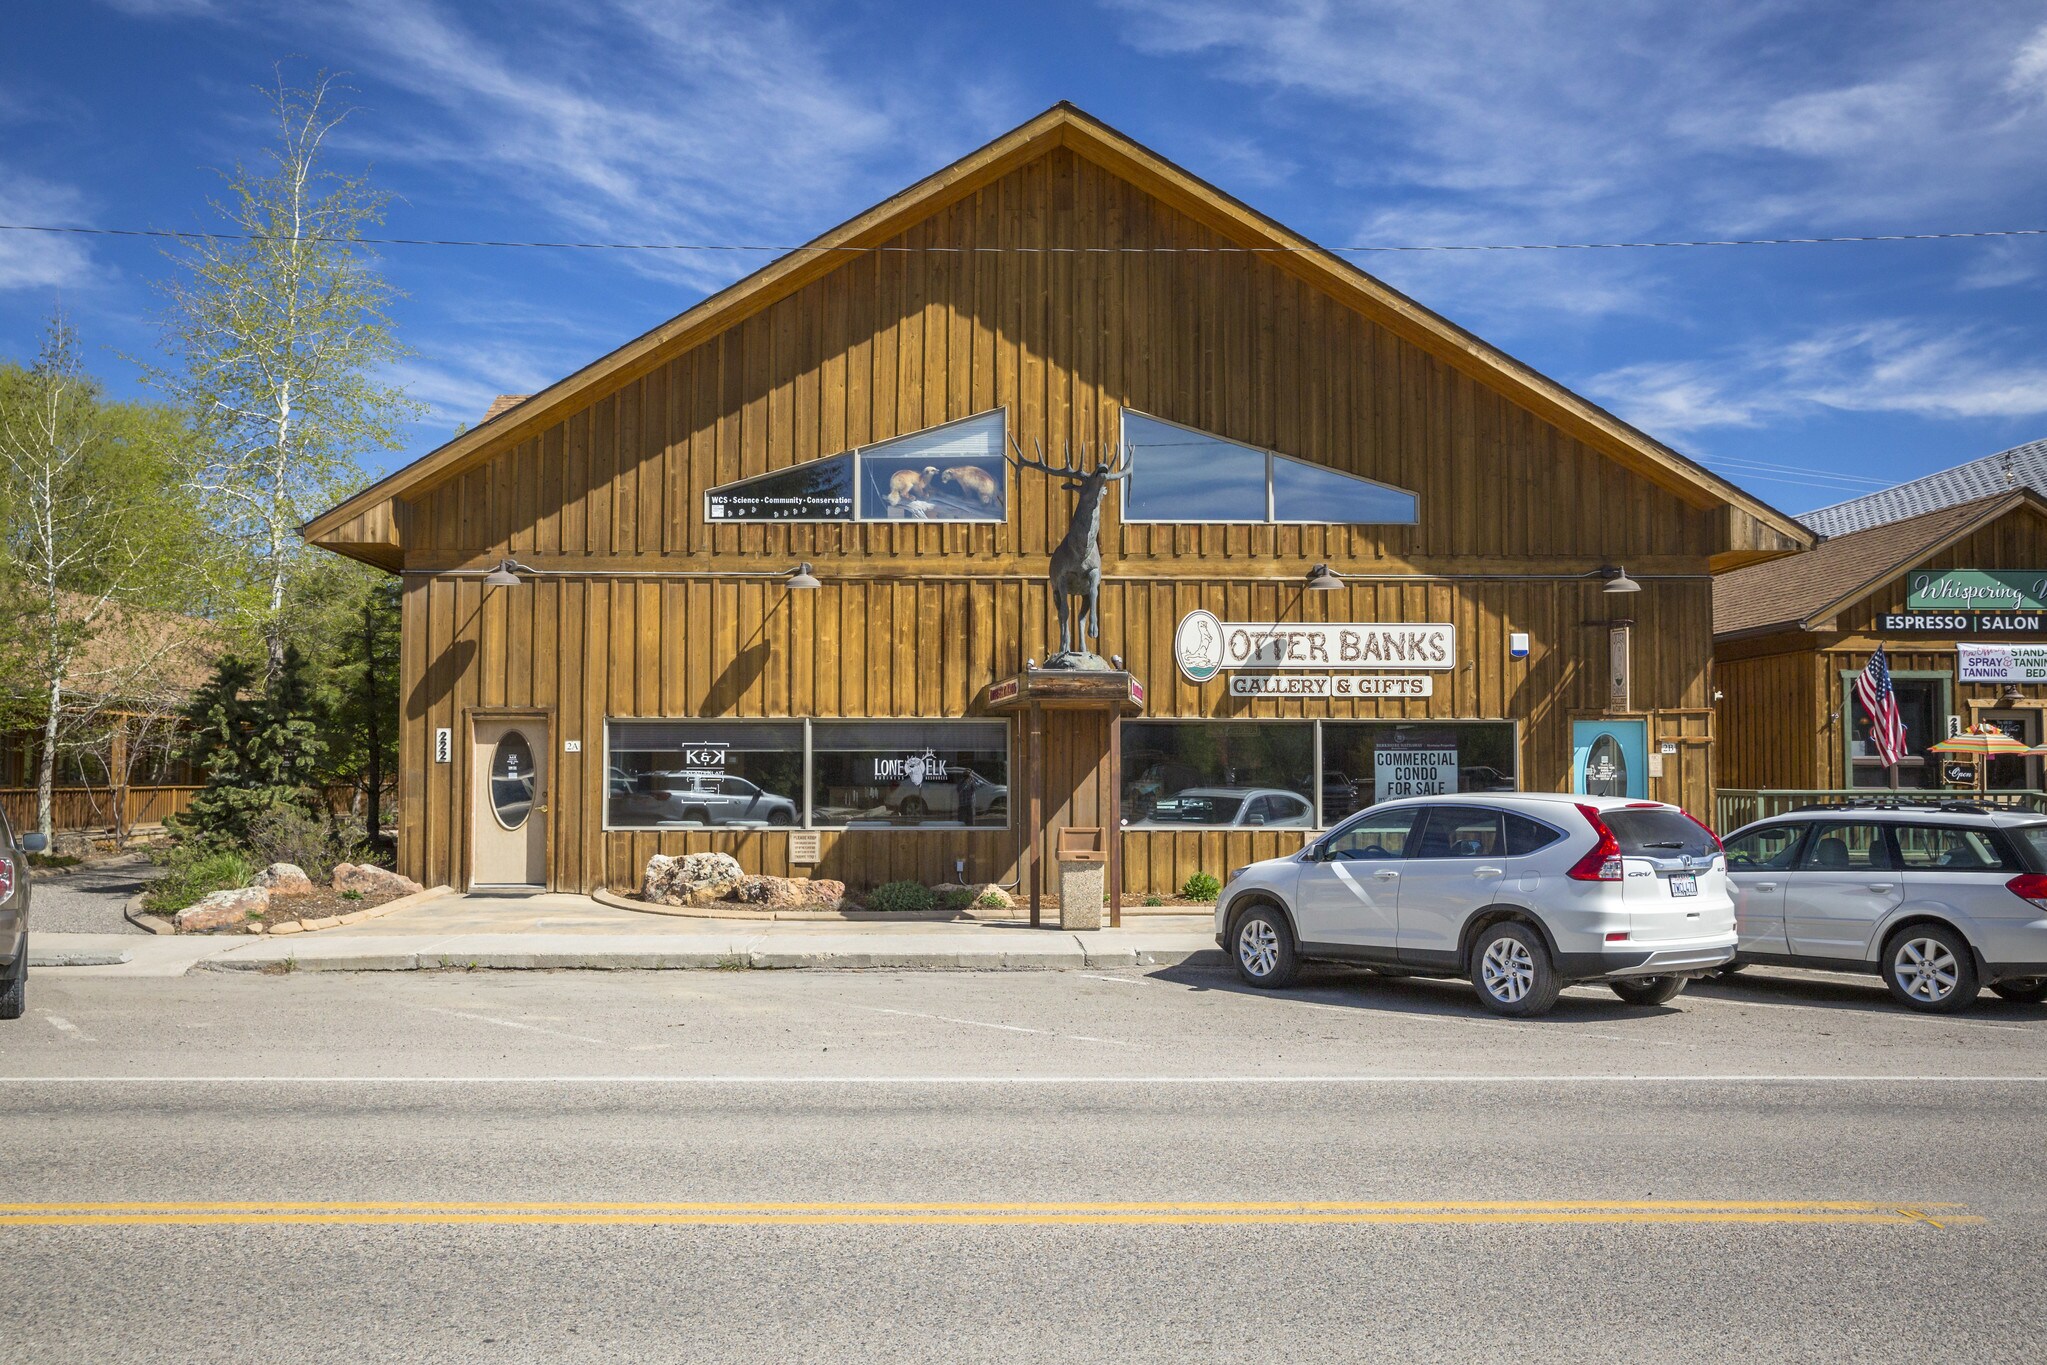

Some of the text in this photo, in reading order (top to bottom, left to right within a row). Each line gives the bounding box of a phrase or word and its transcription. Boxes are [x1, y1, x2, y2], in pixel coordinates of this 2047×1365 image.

[711, 496, 853, 505] WCS Science Community Conservation
[1914, 575, 2025, 610] Whispering
[1885, 616, 2040, 630] ESPRESSO SALON
[1228, 628, 1447, 663] OTTER BANKS
[1968, 658, 2003, 667] SPRAY
[1963, 668, 2046, 678] TANNING BED
[1233, 679, 1424, 694] GALLERY & GIFTS
[439, 731, 448, 761] 222
[567, 742, 579, 751] 2A
[686, 749, 725, 765] K&K
[1377, 752, 1456, 766] COMMERCIAL
[875, 758, 948, 776] LONE ELK
[1395, 766, 1438, 781] CONDO
[1948, 767, 1973, 780] Open
[1387, 781, 1446, 795] FOR SALE
